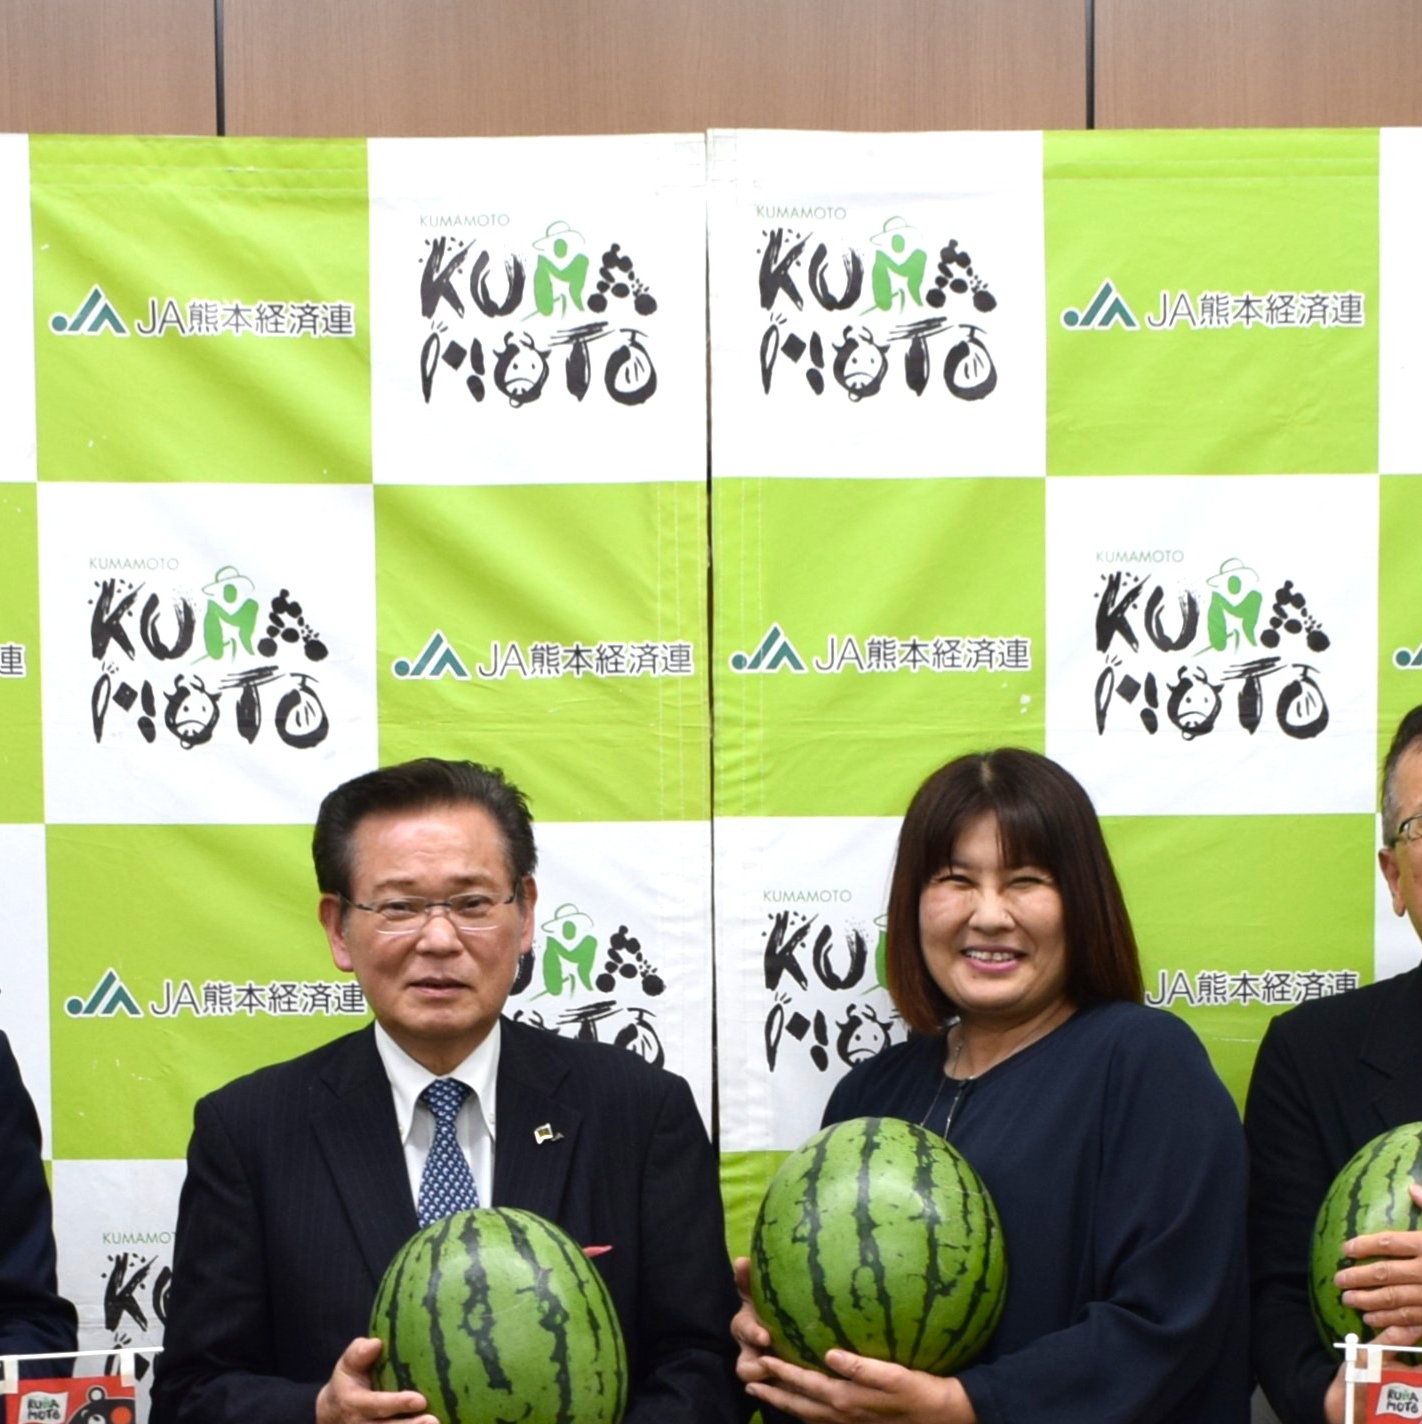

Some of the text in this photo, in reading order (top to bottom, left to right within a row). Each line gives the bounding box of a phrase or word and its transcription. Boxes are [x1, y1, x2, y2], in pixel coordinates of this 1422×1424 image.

[419, 214, 510, 227] KUMAMOTO
[755, 206, 846, 219] KUMAMOTO
[419, 220, 657, 319] KUMA
[758, 216, 998, 314] KUMA
[137, 301, 351, 334] JA熊本経済連
[1148, 294, 1361, 325] JA熊本経済連
[421, 322, 657, 407] MOTO
[759, 315, 998, 401] MOTO
[89, 558, 179, 570] KUMAMOTO
[1096, 552, 1184, 564] KUMAMOTO
[88, 566, 329, 664] KUMA
[1095, 558, 1331, 654] KUMA
[479, 644, 690, 677] JA熊本経済連
[816, 638, 1031, 670] JA熊本経済連
[93, 663, 330, 750] MOTO
[1095, 655, 1330, 741] MOTO
[763, 890, 852, 902] KUMAMOTO
[507, 903, 666, 1001] MA
[762, 910, 888, 995] KU
[765, 991, 899, 1072] MO
[103, 1232, 175, 1244] KUMAMO
